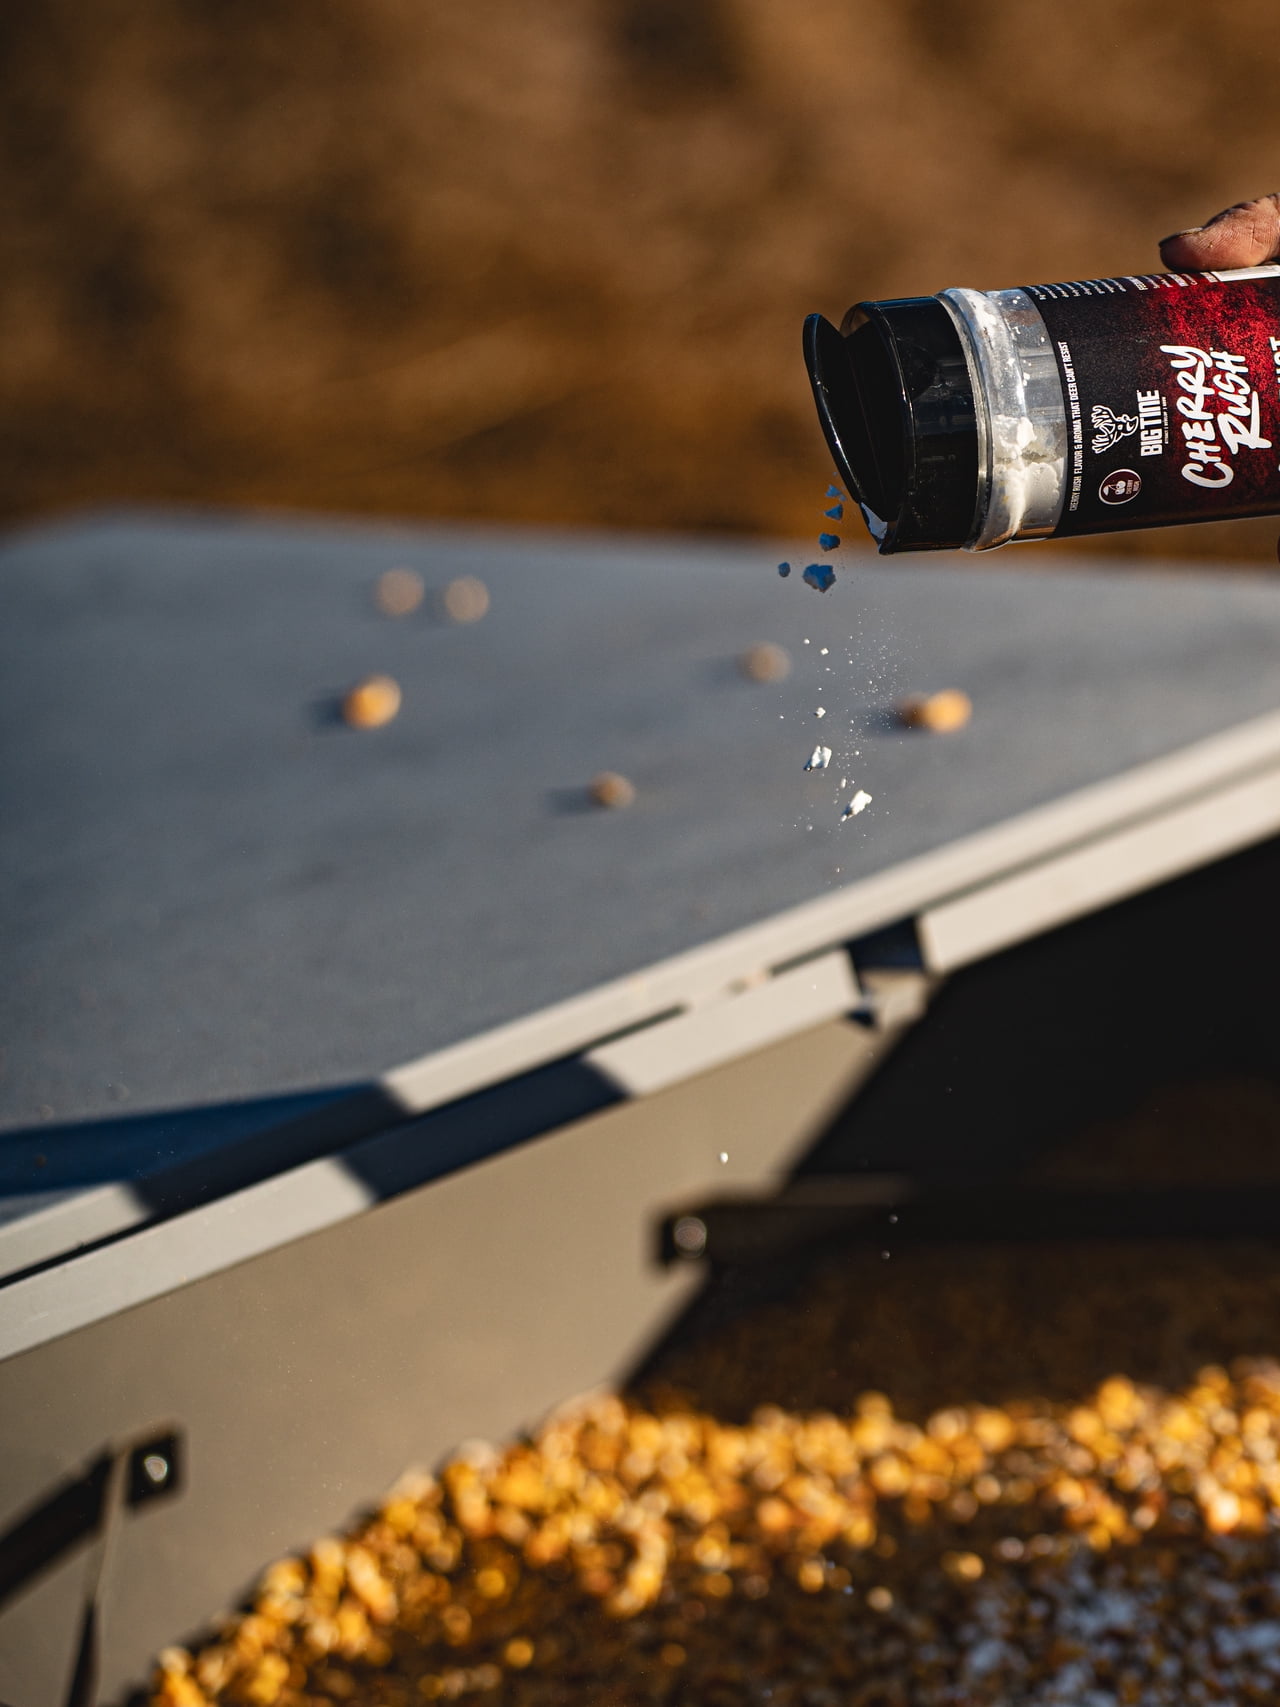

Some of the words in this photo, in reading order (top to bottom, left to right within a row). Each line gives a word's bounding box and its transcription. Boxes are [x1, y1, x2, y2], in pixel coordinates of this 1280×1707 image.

[1058, 341, 1072, 362] RESIST
[1064, 363, 1076, 382] CAN'T
[1068, 383, 1079, 400] DEER
[1071, 401, 1081, 419] THAT
[1210, 351, 1272, 455] RUSH
[1160, 345, 1234, 488] CHERRY
[1072, 419, 1082, 443] AROMA
[1074, 450, 1082, 474] FLAVOR
